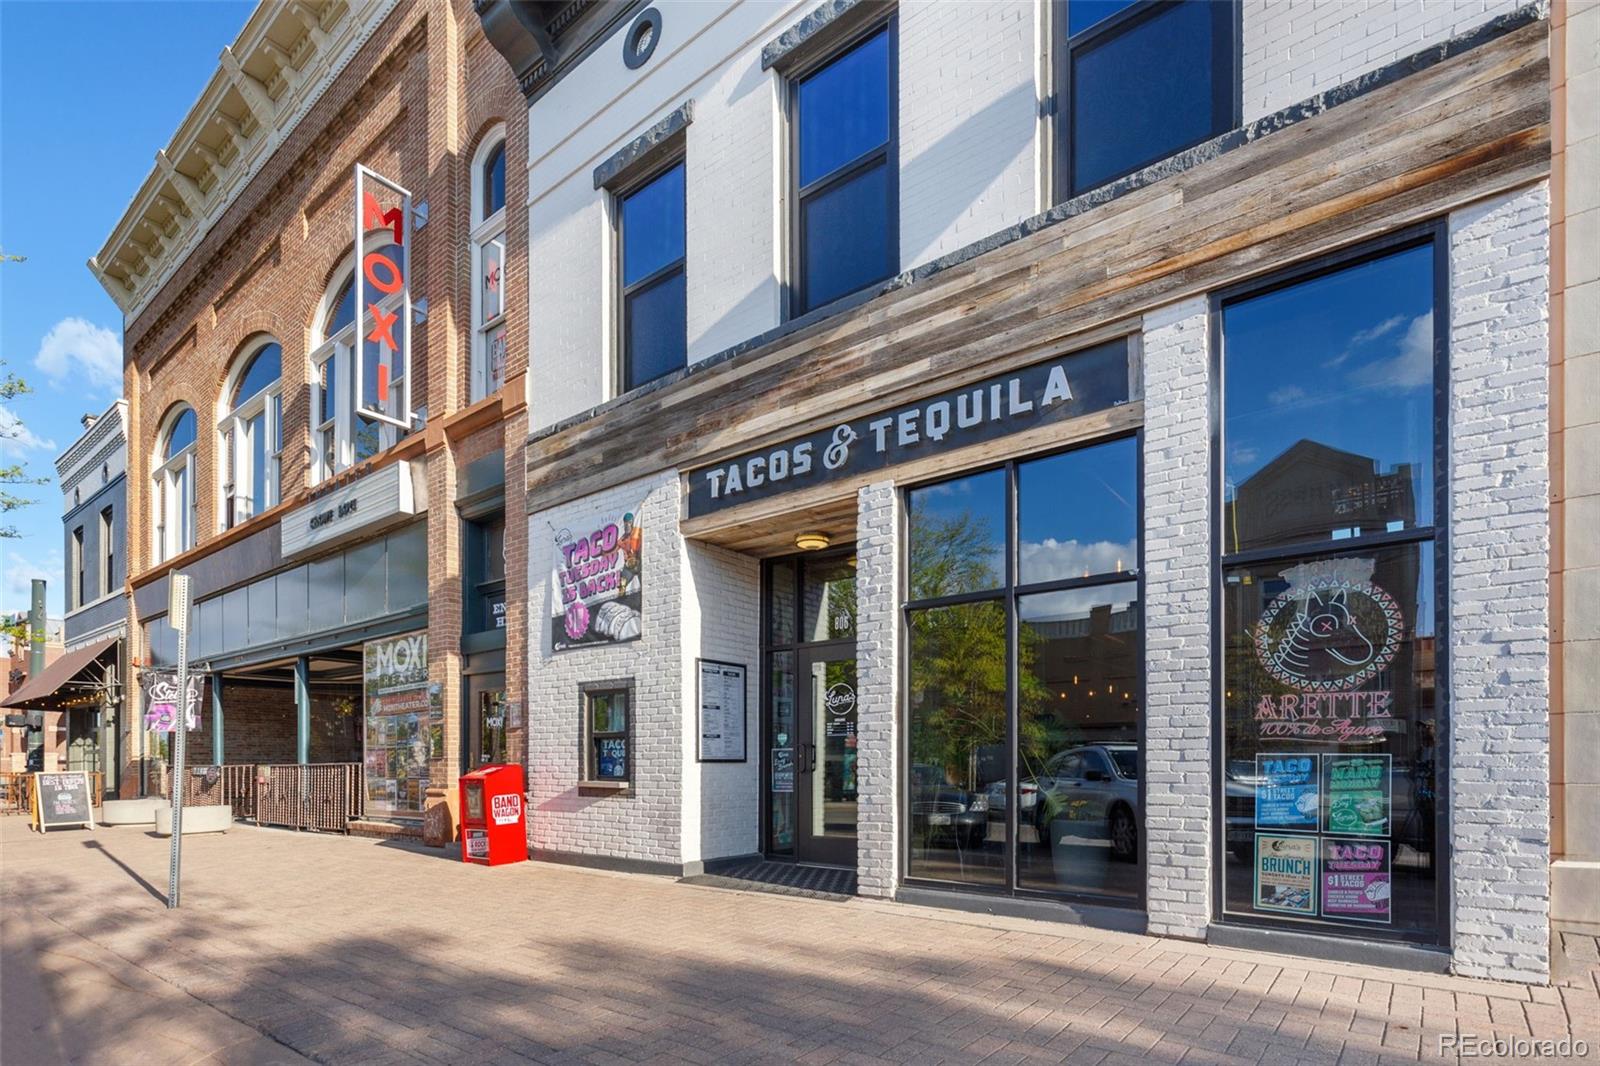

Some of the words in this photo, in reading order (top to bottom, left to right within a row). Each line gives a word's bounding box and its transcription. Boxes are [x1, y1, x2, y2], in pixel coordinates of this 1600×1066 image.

[363, 191, 403, 401] MOXI
[706, 441, 813, 498] TACOS
[823, 423, 858, 470] &
[869, 365, 1074, 453] TEQUILA
[562, 523, 619, 568] TACO
[559, 552, 619, 587] TUESDAY
[561, 586, 577, 604] IS
[580, 570, 622, 599] BACK!
[377, 634, 428, 676] MOXI
[1254, 690, 1391, 720] ARETTE
[1260, 722, 1301, 736] 100%
[1263, 758, 1312, 773] TACO
[494, 795, 519, 809] BAND
[494, 807, 519, 818] WAGON
[1328, 844, 1384, 860] TACO
[1262, 857, 1311, 875] BRUNCH
[1328, 875, 1338, 887] $1
[1341, 880, 1365, 888] TACOS
